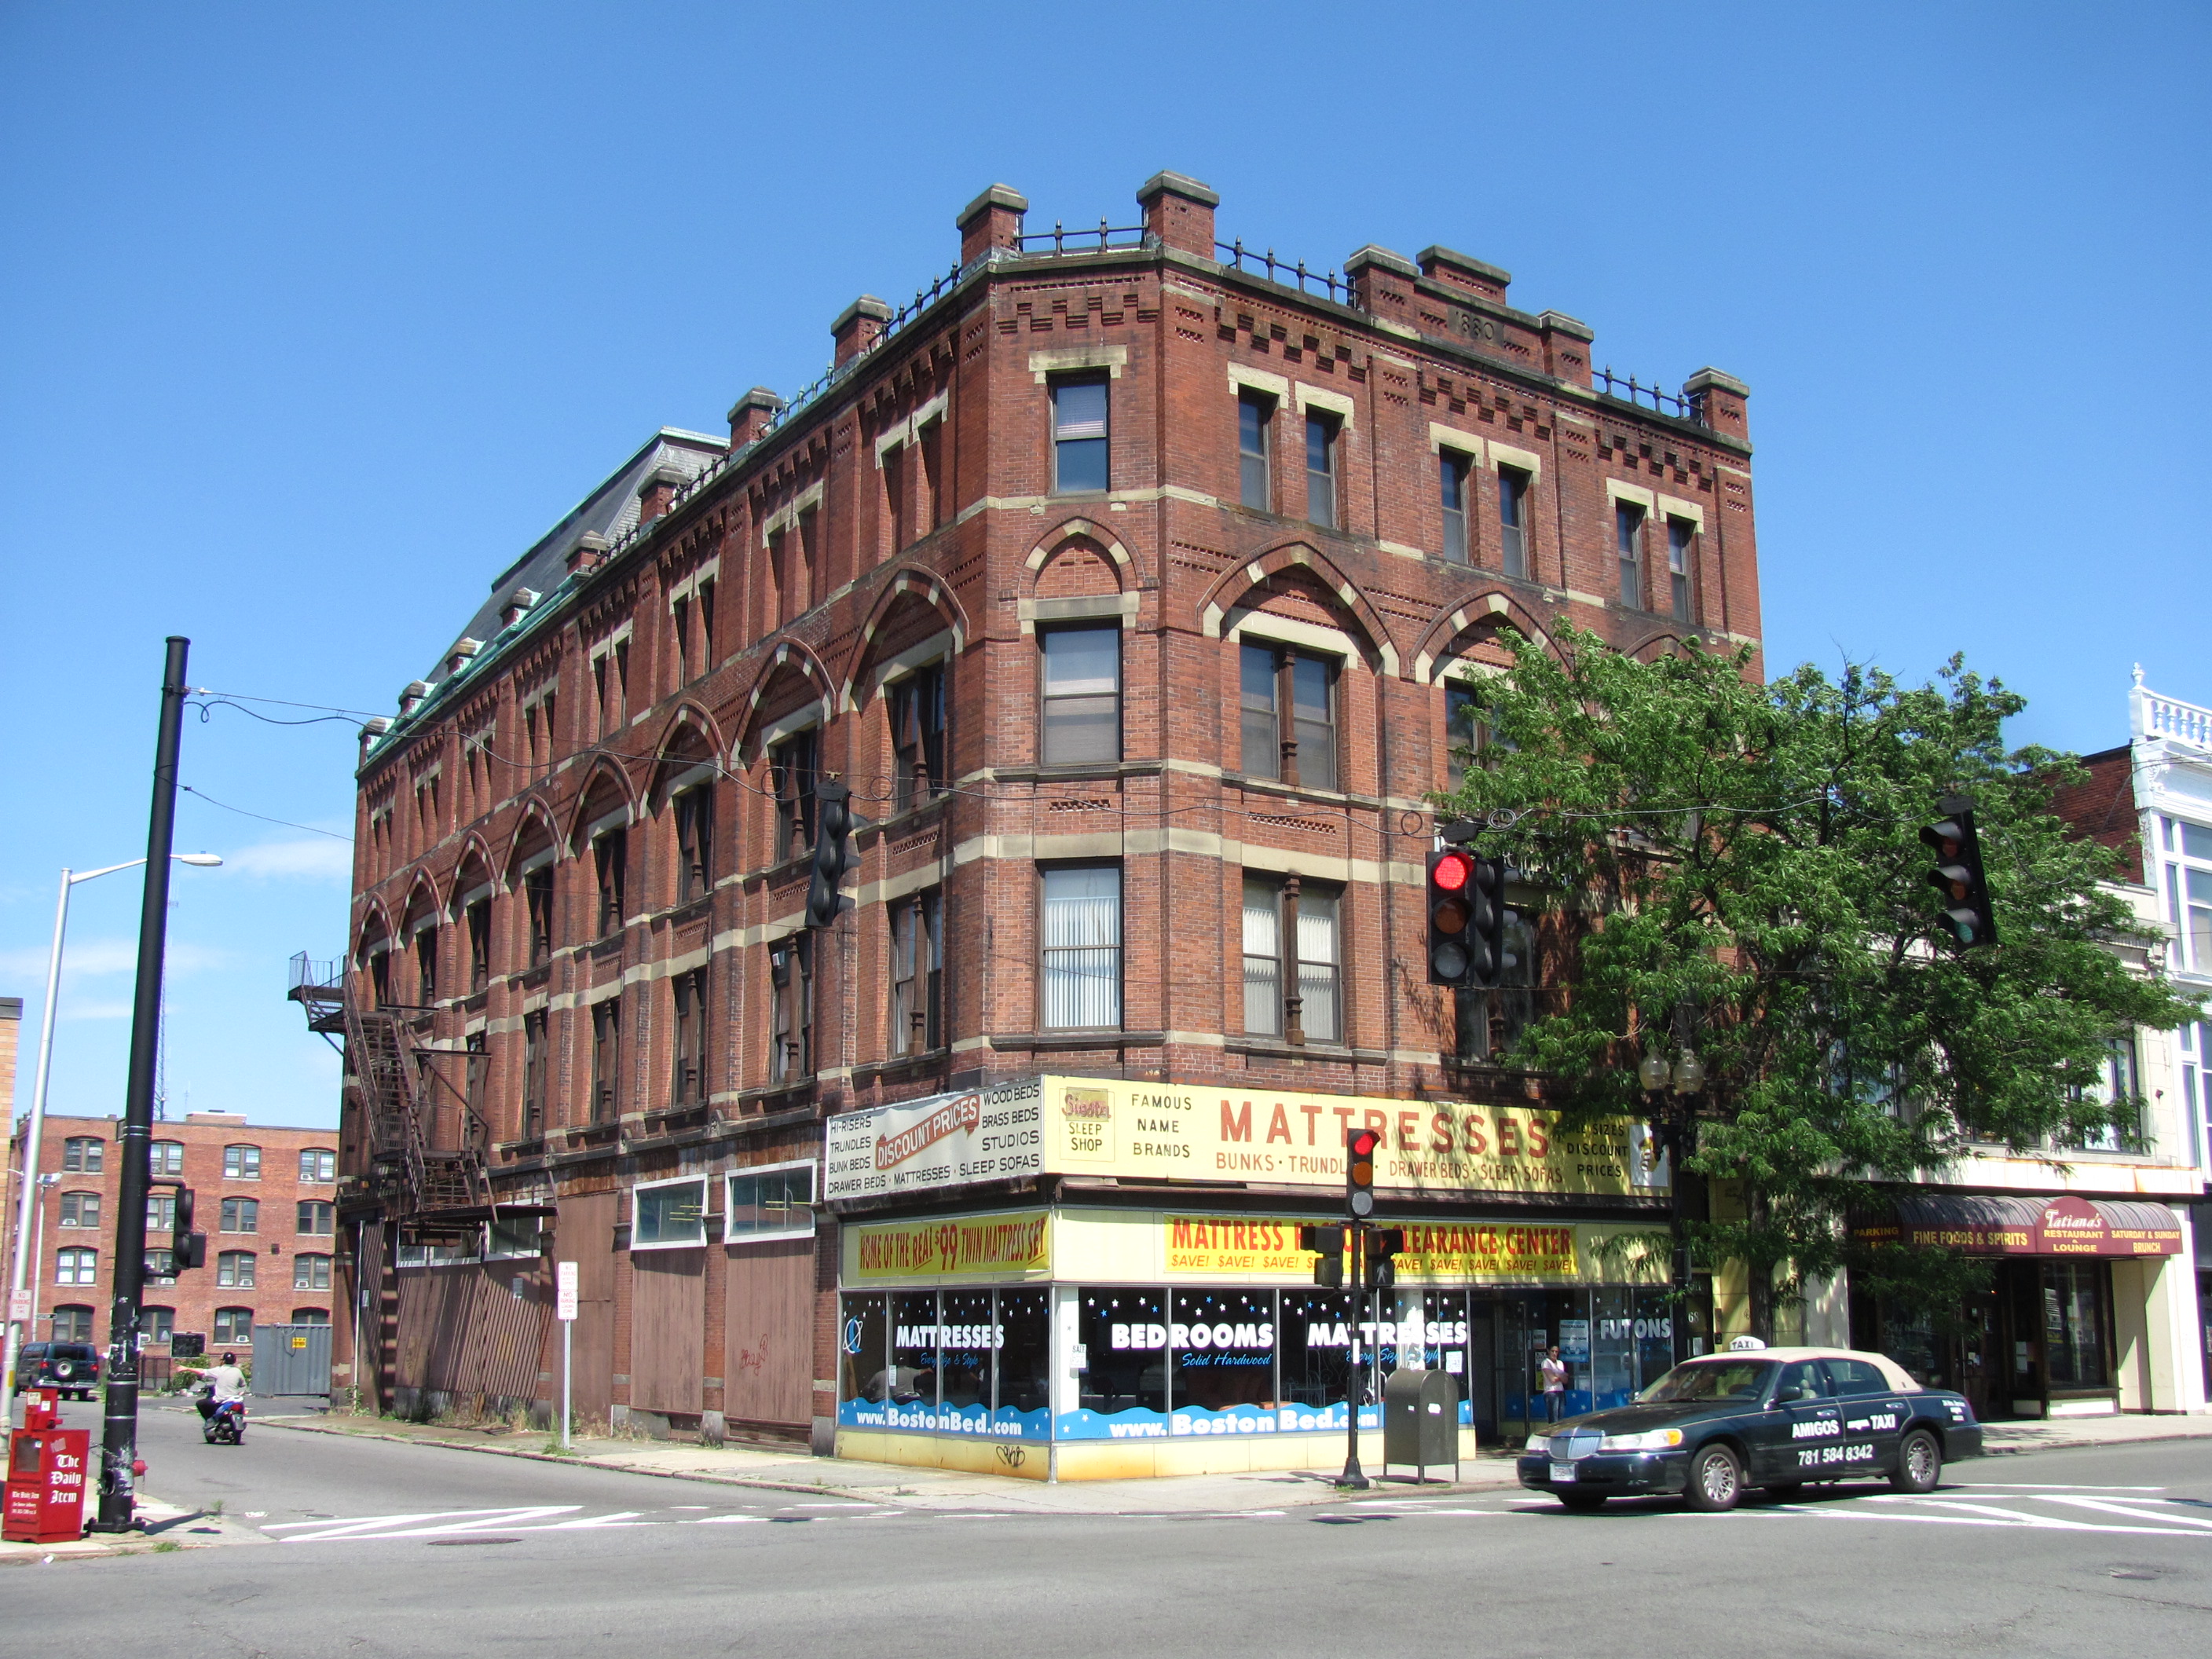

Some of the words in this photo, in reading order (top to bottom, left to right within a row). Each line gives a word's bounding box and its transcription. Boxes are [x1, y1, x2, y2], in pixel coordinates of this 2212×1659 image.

[983, 1090, 1013, 1106] WOOD
[1014, 1084, 1040, 1101] BEDS
[1131, 1093, 1192, 1111] FAMOUS
[830, 1115, 872, 1134] HI-RISERS
[982, 1111, 1009, 1129] BRASS
[1012, 1107, 1039, 1124] BEDS
[1137, 1119, 1179, 1133] NAME
[877, 1121, 931, 1166] DISCOUNT
[932, 1097, 977, 1138] PRICES
[1068, 1122, 1102, 1135] SLEEP
[1221, 1100, 1548, 1159] MATTRESSES
[1592, 1123, 1624, 1137] SIZES
[830, 1136, 872, 1155] TRUNDLES
[982, 1130, 1040, 1152] STUDIOS
[1071, 1137, 1103, 1152] SHOP
[1566, 1143, 1628, 1157] DISCOUNT
[1133, 1142, 1190, 1159] BRANDS
[829, 1178, 862, 1194] DRAWER
[864, 1174, 886, 1189] BEDS
[894, 1165, 950, 1185] MATTRESSES
[959, 1159, 996, 1177] SLEEP
[999, 1153, 1040, 1172] SOFAS
[830, 1159, 848, 1174] BUNK
[849, 1156, 871, 1171] BEDS
[1216, 1152, 1275, 1171] BUNKS
[1289, 1155, 1346, 1175] TRUNDL
[1390, 1160, 1437, 1178] DRAWER
[1441, 1163, 1470, 1179] BEDS
[1481, 1163, 1518, 1181] SLEEP
[1524, 1166, 1563, 1184] SOFAS
[1577, 1163, 1622, 1177] PRICES
[2044, 1208, 2103, 1229] Tatiana's
[1172, 1219, 1284, 1251] MATTRESS
[1506, 1226, 1571, 1255] CENTER
[1854, 1226, 1899, 1237] PARKING
[1913, 1230, 1938, 1244] FINE
[1939, 1230, 1974, 1246] FOODS
[1976, 1232, 1984, 1245] &
[1987, 1231, 2029, 1247] SPIRITS
[2044, 1229, 2104, 1239] RESTAURANT
[2111, 1230, 2146, 1240] SATURDAY
[2148, 1231, 2152, 1240] &
[2154, 1230, 2181, 1240] SUNDAY
[860, 1233, 882, 1270] HOME
[884, 1233, 893, 1269] OF
[896, 1232, 910, 1268] THE
[913, 1225, 934, 1267] REAL
[935, 1222, 958, 1271] $99
[961, 1225, 983, 1264] TWIN
[983, 1221, 1026, 1263] MATTRESS
[1027, 1215, 1046, 1260] SET
[2053, 1243, 2098, 1253] LOUNGE
[2133, 1242, 2161, 1254] BRUNCH
[1171, 1254, 1210, 1267] $AVE!
[1218, 1255, 1254, 1268] $AVE!
[1262, 1256, 1299, 1269] $AVE!
[1430, 1258, 1463, 1271] $AVE!
[1468, 1259, 1500, 1271] $AVE!
[1506, 1259, 1537, 1272] $AVE!
[1543, 1260, 1573, 1272] $AVE!
[895, 1324, 1005, 1349] MATTRESSES
[1111, 1323, 1274, 1349] BEDROOMS
[1599, 1317, 1672, 1340] FUTONS
[1071, 1344, 1086, 1353] SALE
[1732, 1340, 1754, 1350] TAXI
[1182, 1352, 1210, 1367] Solid
[1214, 1351, 1273, 1366] Hardwood
[857, 1408, 1022, 1435] www.BostonBed.com
[1109, 1407, 1378, 1438] www.BostonBed.cm
[1792, 1419, 1840, 1438] AMIGOS
[1870, 1413, 1897, 1430] TAXI
[56, 1454, 80, 1468] The
[1798, 1448, 1819, 1467] 781
[1822, 1445, 1844, 1463] 584
[1845, 1443, 1873, 1461] 8342
[49, 1470, 82, 1487] Daily
[49, 1489, 78, 1503] Item
